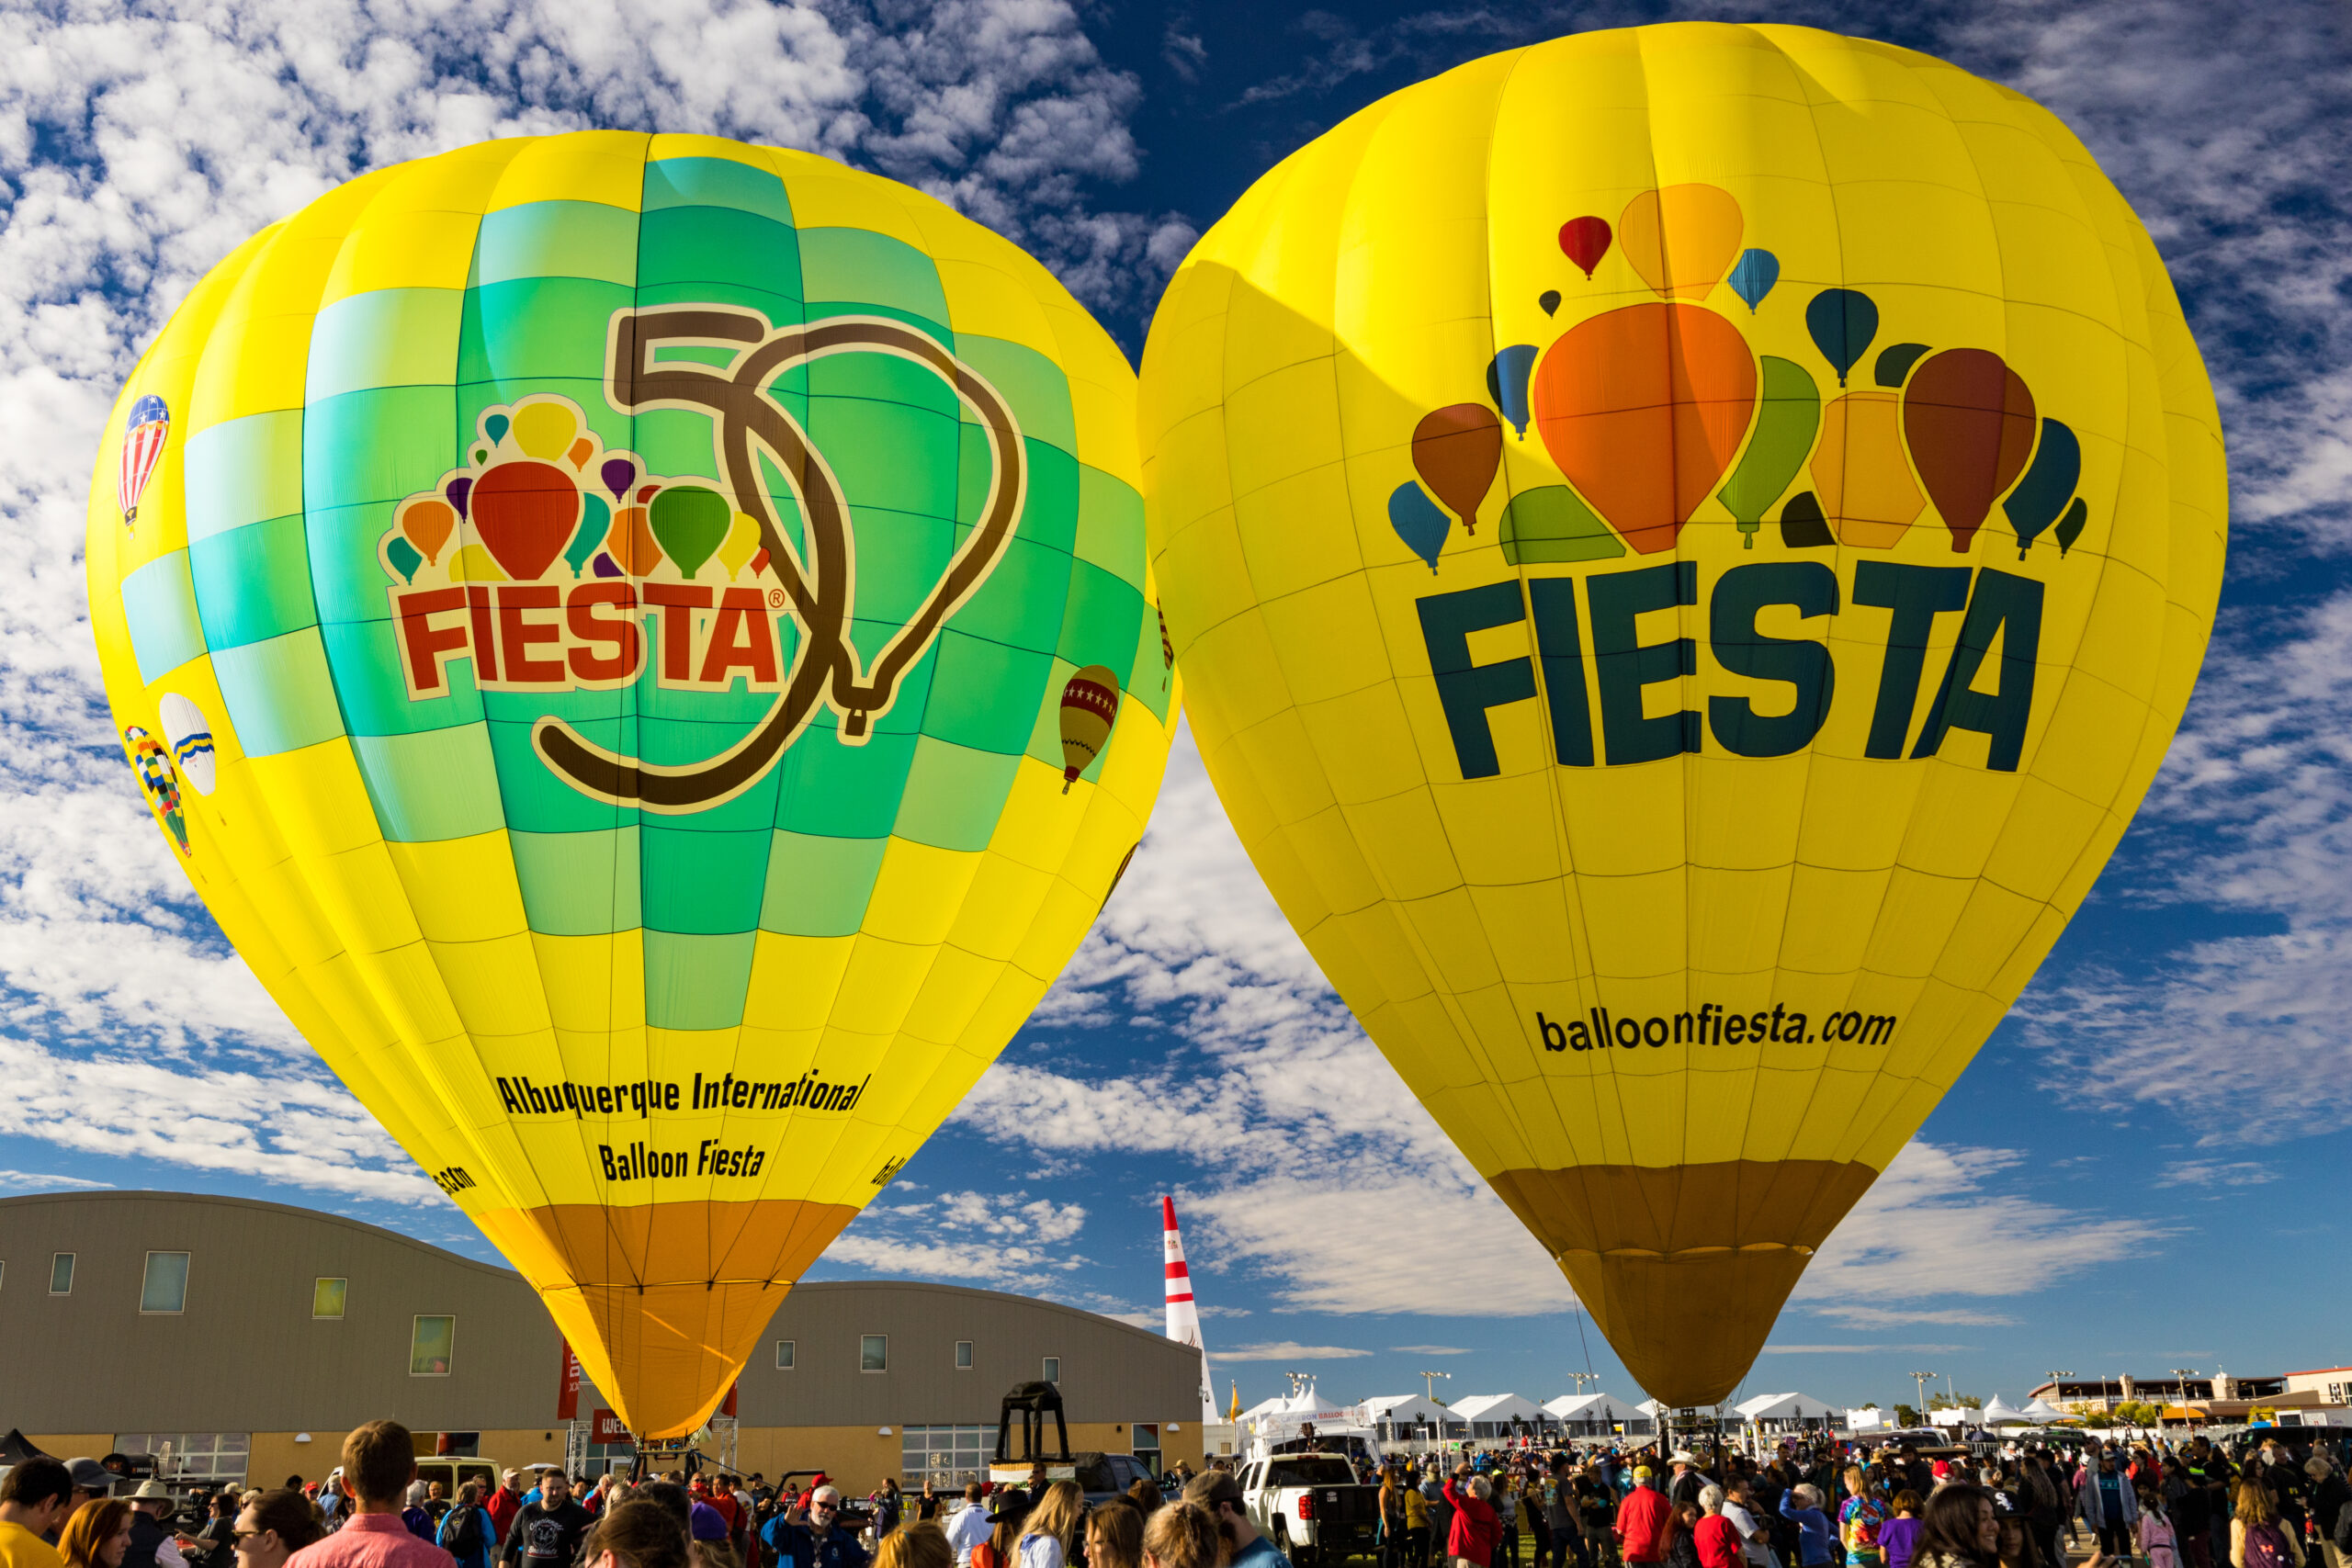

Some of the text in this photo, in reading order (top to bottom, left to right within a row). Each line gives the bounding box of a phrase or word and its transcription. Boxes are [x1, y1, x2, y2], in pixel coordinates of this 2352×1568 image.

[1415, 559, 2045, 780] FIESTA
[1536, 1001, 1897, 1053] balloonfiesta.com
[496, 1068, 872, 1120] Albuquerque International
[598, 1138, 765, 1181] Balloon Fiesta
